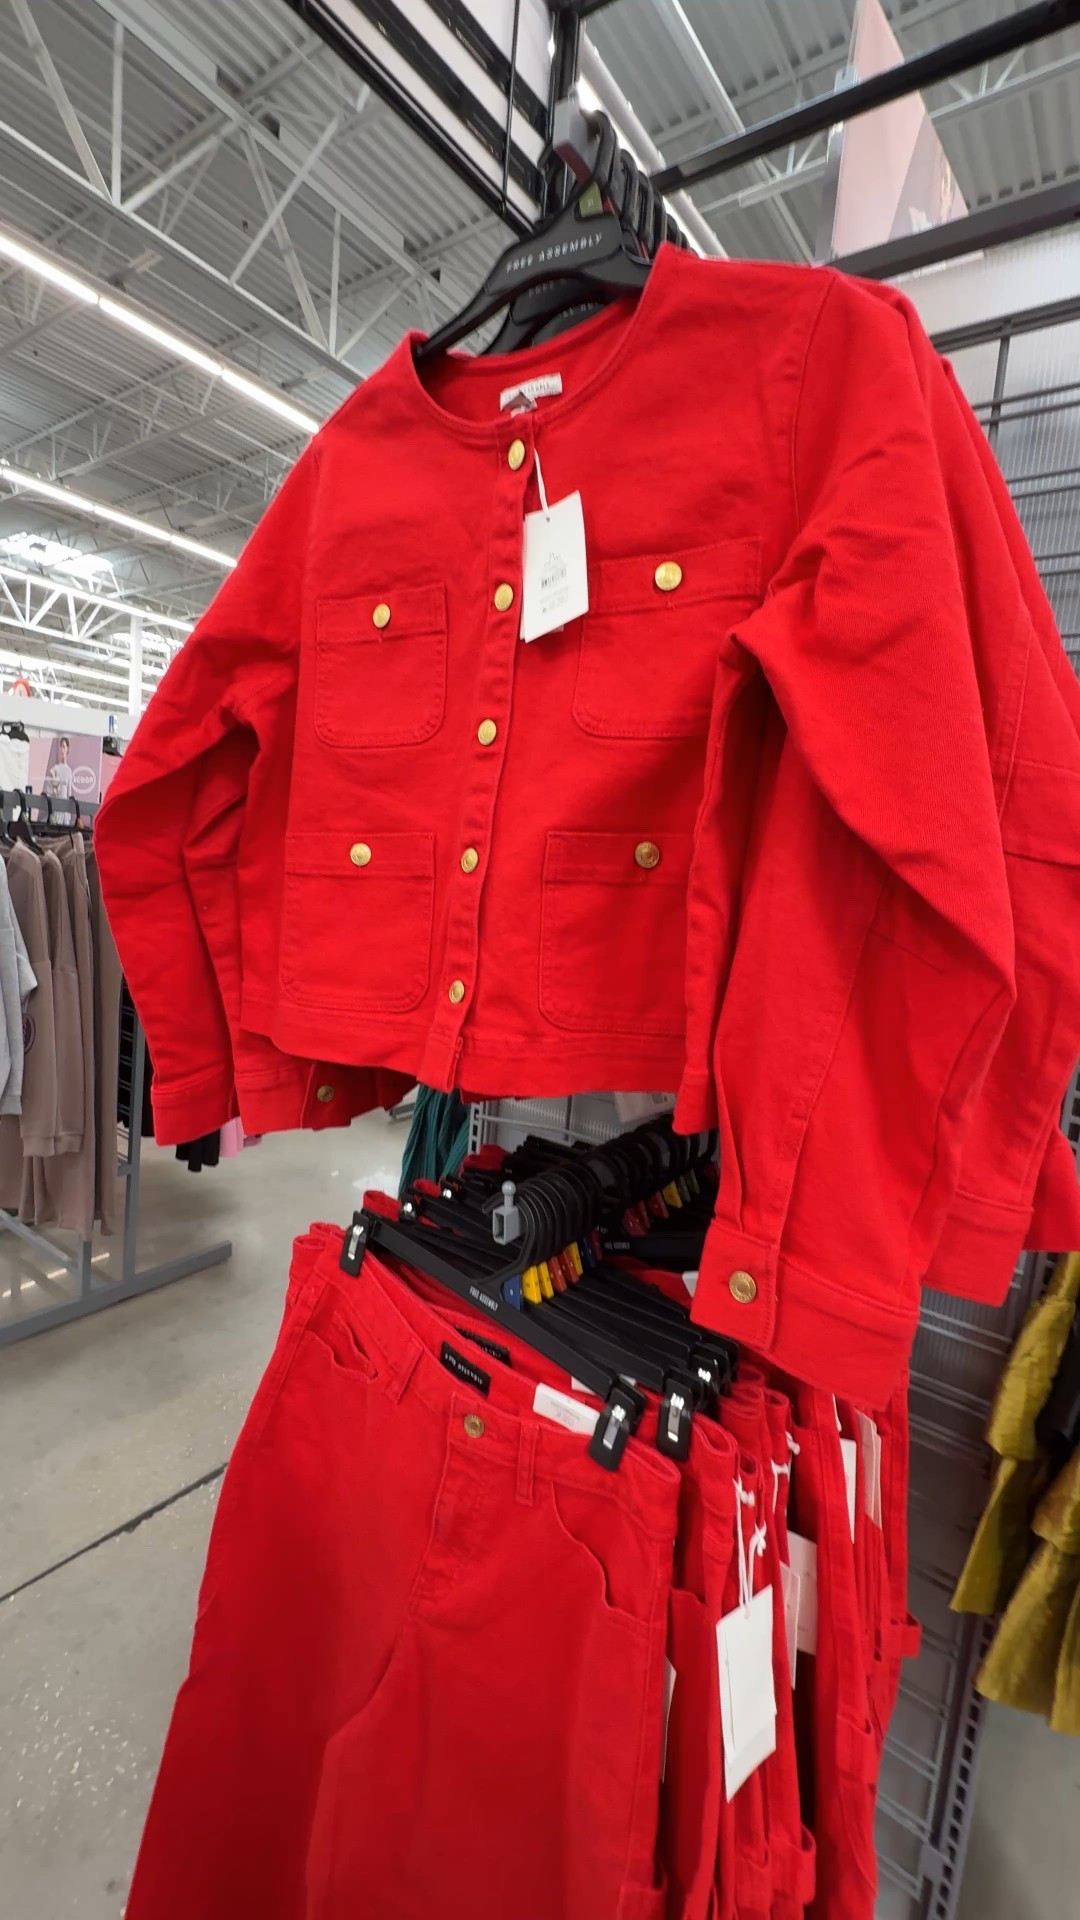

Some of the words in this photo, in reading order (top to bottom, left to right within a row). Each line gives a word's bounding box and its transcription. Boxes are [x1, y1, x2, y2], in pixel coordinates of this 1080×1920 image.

[506, 254, 533, 274] FREE
[538, 231, 602, 262] ASSEMBLY
[73, 775, 94, 784] SCOOP
